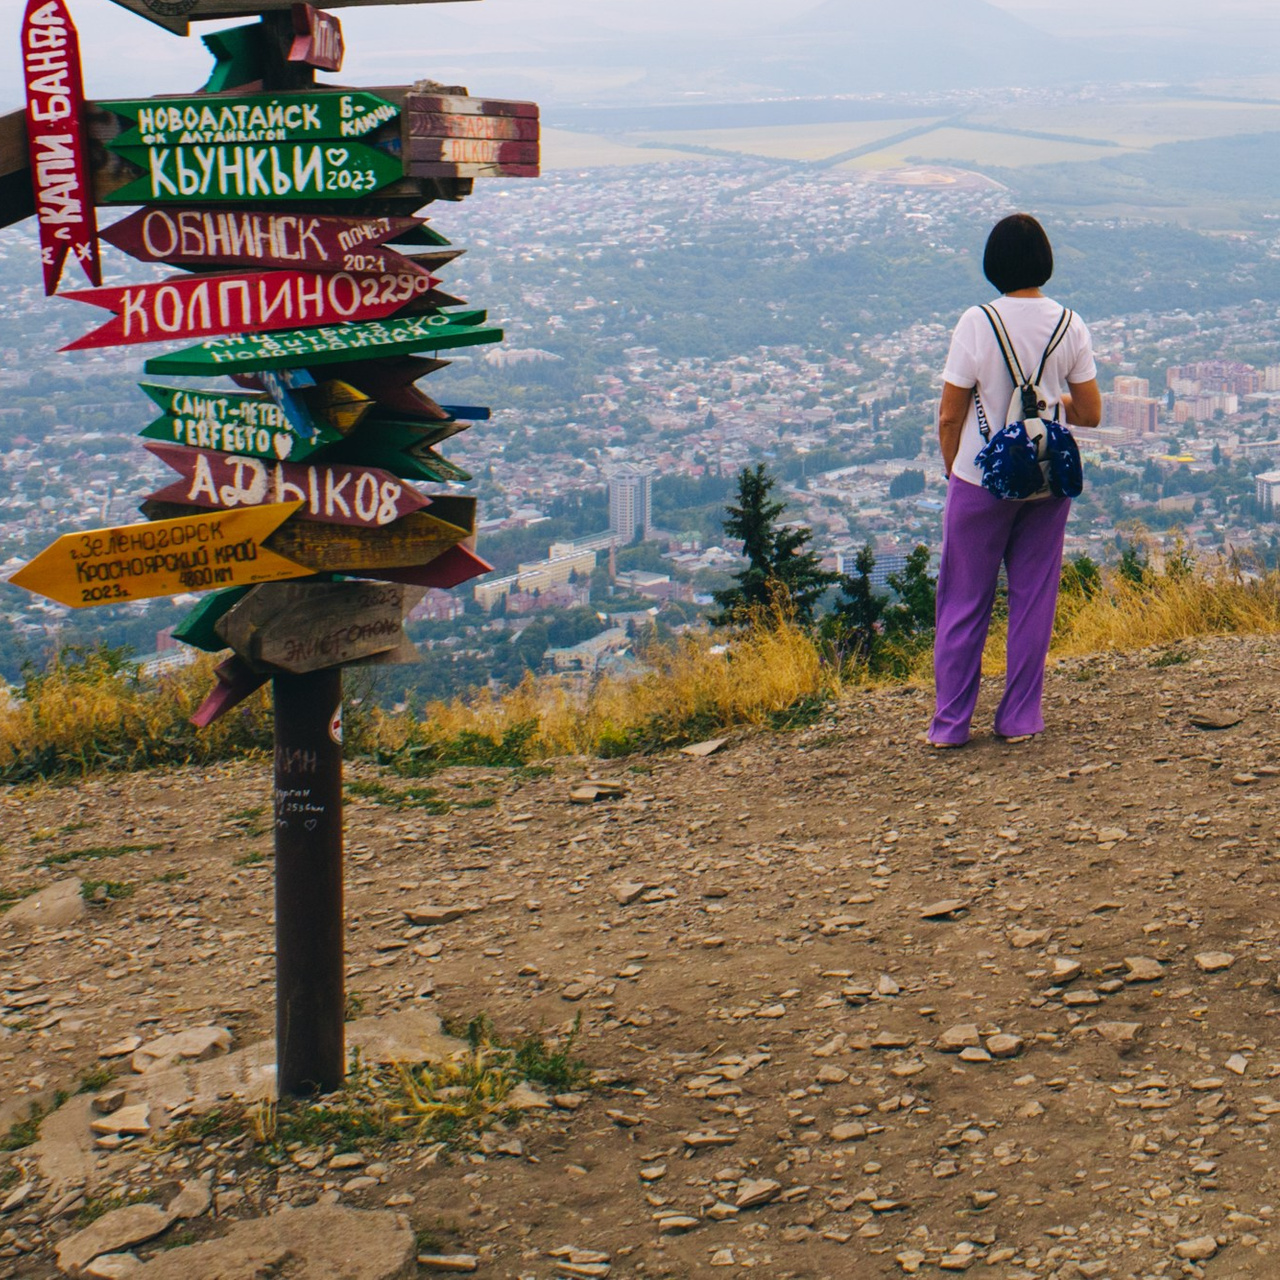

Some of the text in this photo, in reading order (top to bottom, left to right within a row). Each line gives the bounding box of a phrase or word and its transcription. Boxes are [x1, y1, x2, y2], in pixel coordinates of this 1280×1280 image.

[26, 0, 73, 123] БАНДА
[138, 100, 321, 134] НОВОАЛТАЙСК
[340, 104, 398, 137] КЛЮЧИ
[142, 128, 286, 145] ФК АЛТАЙВАГОН
[32, 133, 84, 225] КАПИ
[326, 170, 377, 192] 2023
[143, 210, 328, 261] ОБНИНСК
[344, 254, 386, 272] 2021
[122, 271, 430, 336] КОЛПИНО 2290
[172, 417, 270, 454] PERFECTO
